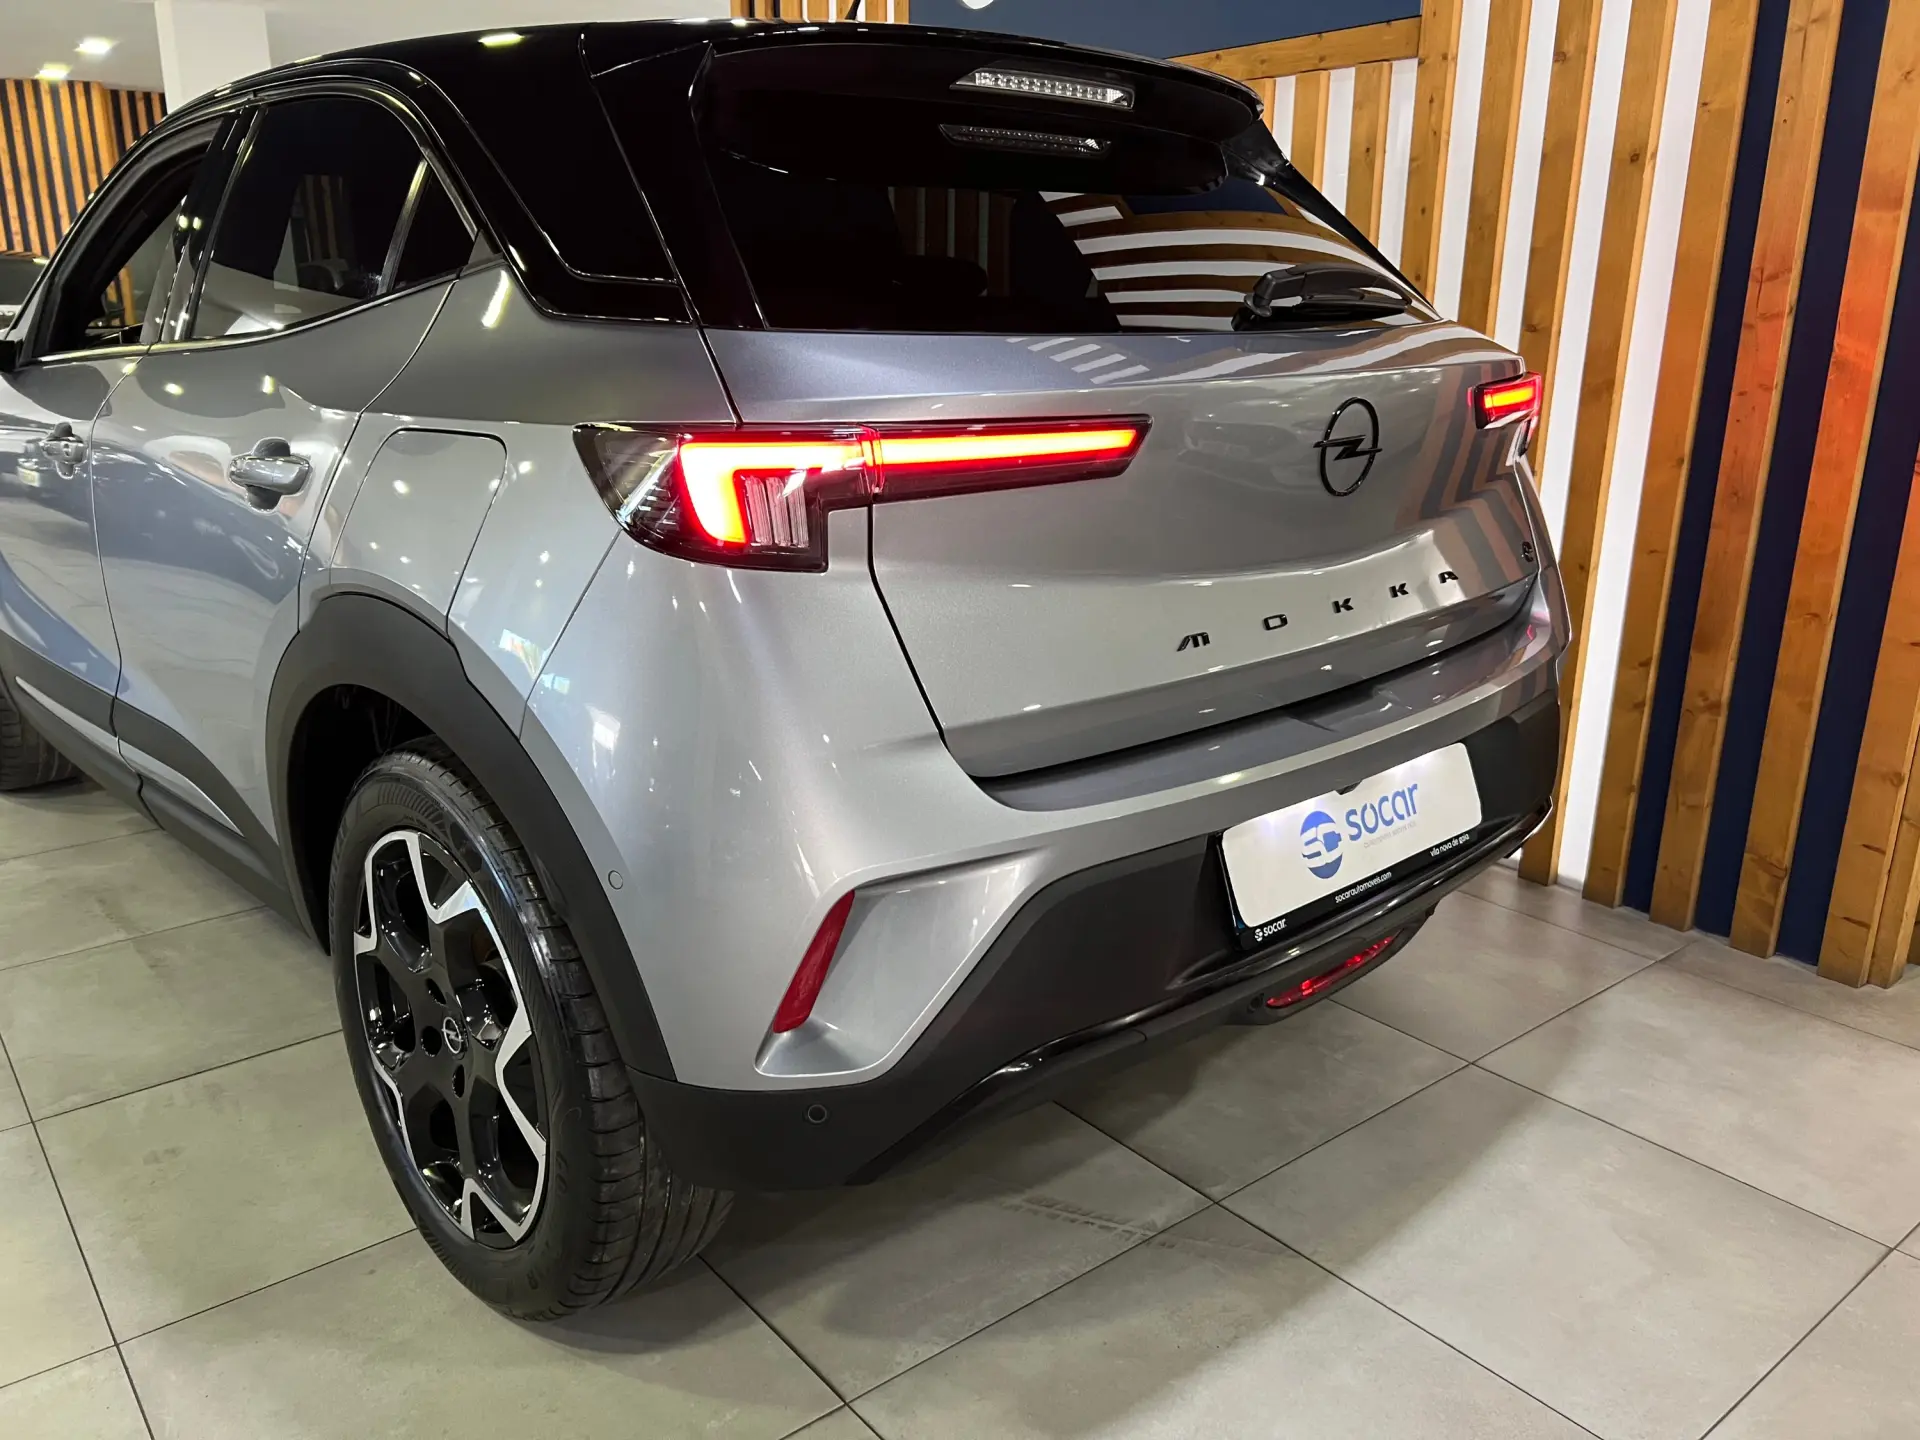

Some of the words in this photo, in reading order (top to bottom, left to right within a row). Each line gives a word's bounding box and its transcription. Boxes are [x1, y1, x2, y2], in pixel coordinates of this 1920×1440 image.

[1176, 570, 1459, 652] MOKKA
[1345, 783, 1418, 841] socar
[1452, 838, 1459, 847] de
[1335, 871, 1392, 903] socarautomoveis.com
[1263, 918, 1286, 937] socar
